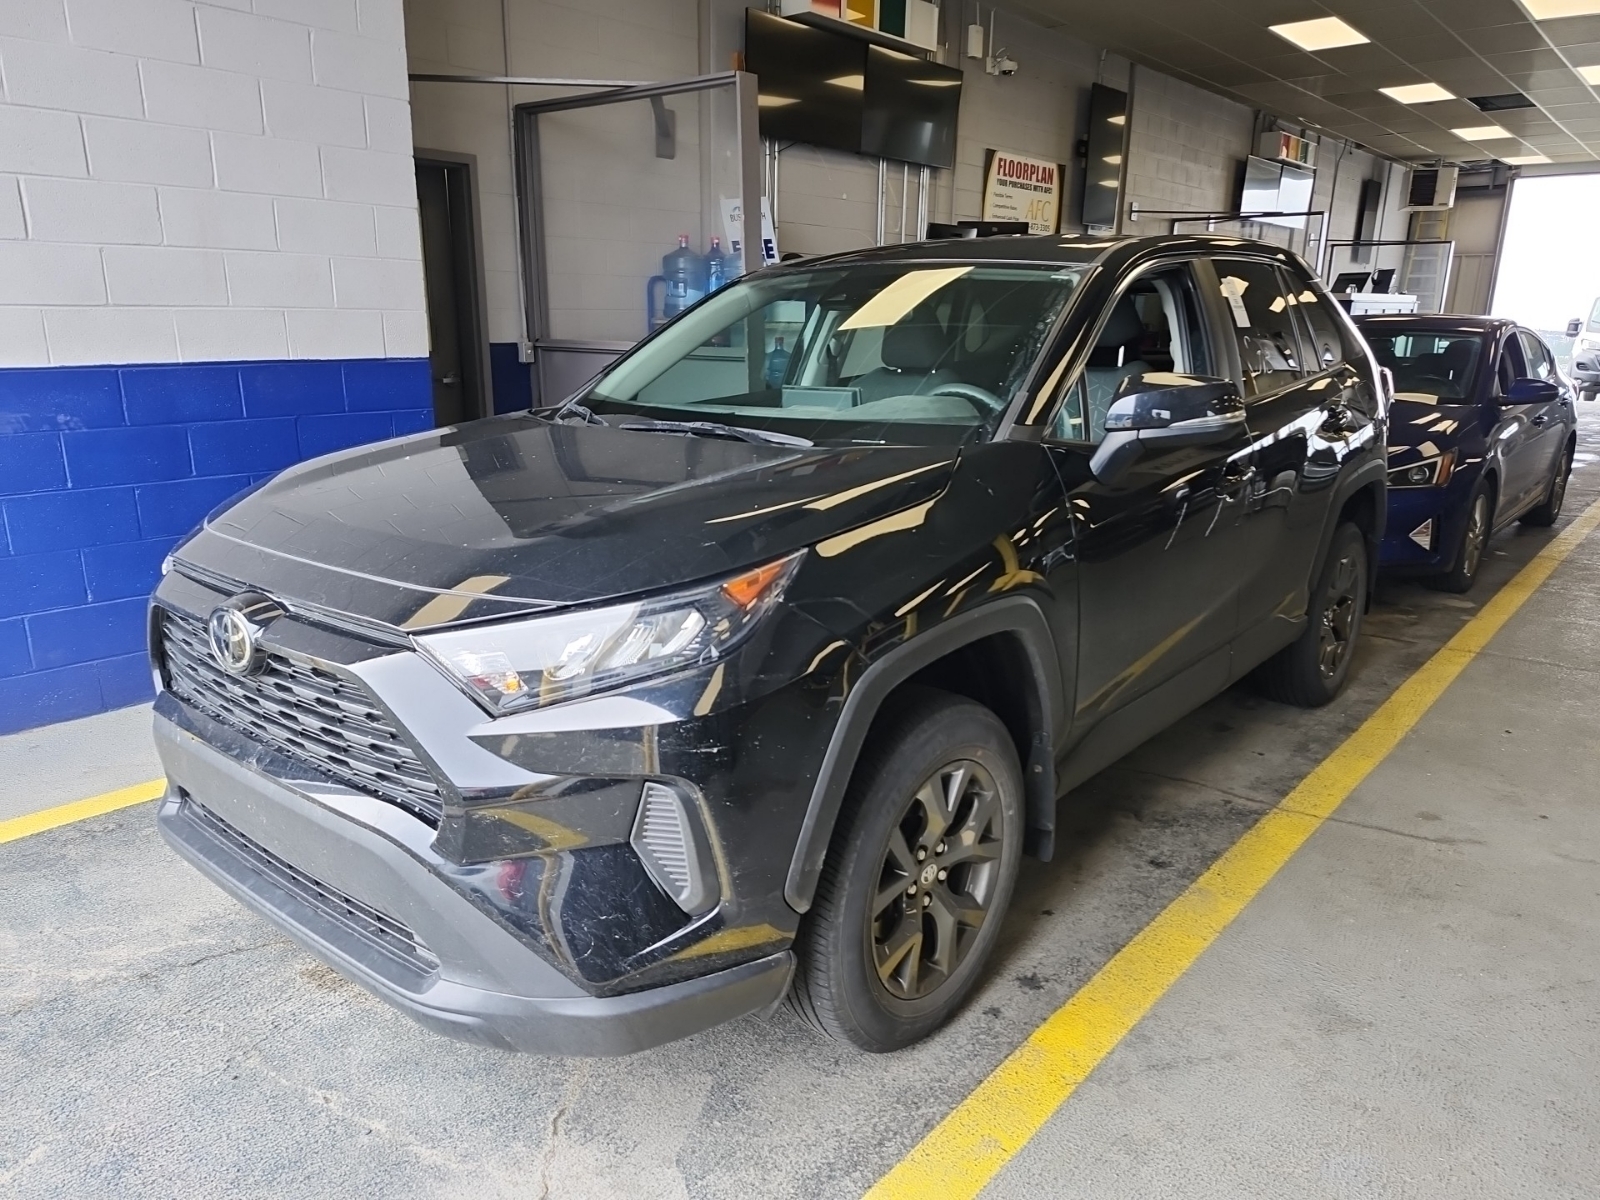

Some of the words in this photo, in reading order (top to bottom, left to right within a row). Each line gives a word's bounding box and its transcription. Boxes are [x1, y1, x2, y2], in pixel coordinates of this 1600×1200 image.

[997, 157, 1054, 185] FLOORPLAN
[997, 178, 1008, 187] YOUR
[1008, 180, 1033, 191] PURCHASES
[1033, 184, 1044, 193] WITH
[1025, 198, 1051, 222] AFC
